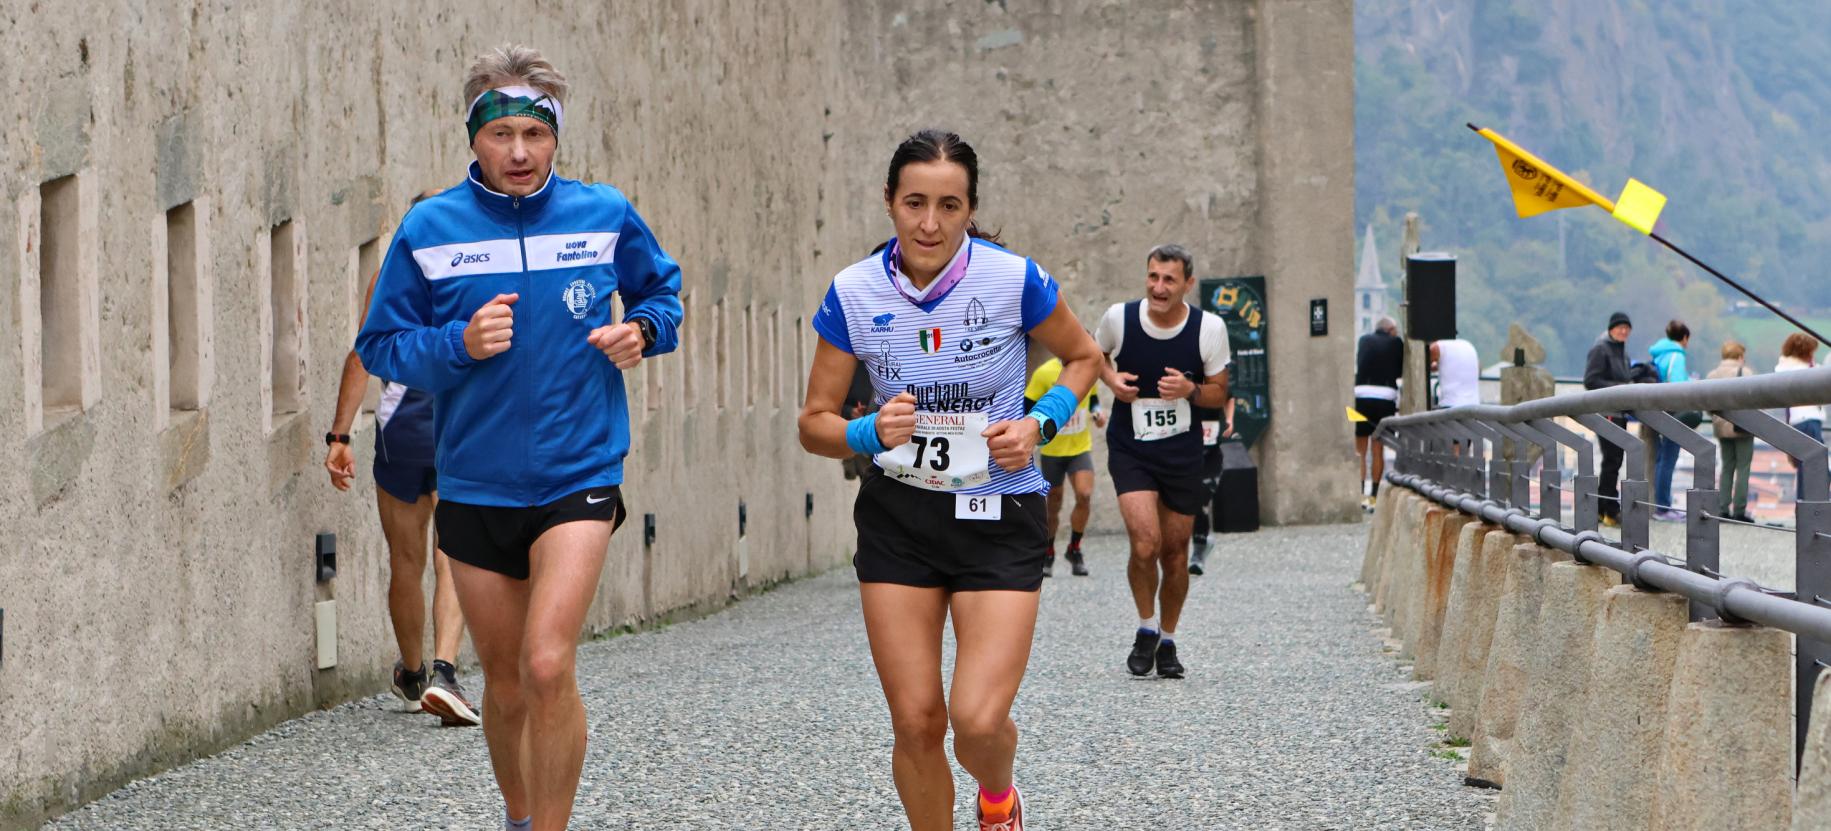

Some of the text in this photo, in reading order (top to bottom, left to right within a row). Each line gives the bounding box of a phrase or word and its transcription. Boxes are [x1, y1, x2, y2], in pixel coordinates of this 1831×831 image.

[463, 252, 490, 264] asics
[556, 250, 598, 262] Fantolino
[877, 365, 902, 380] FIX
[1143, 409, 1177, 427] 155
[911, 434, 950, 472] 73
[968, 497, 987, 512] 61
